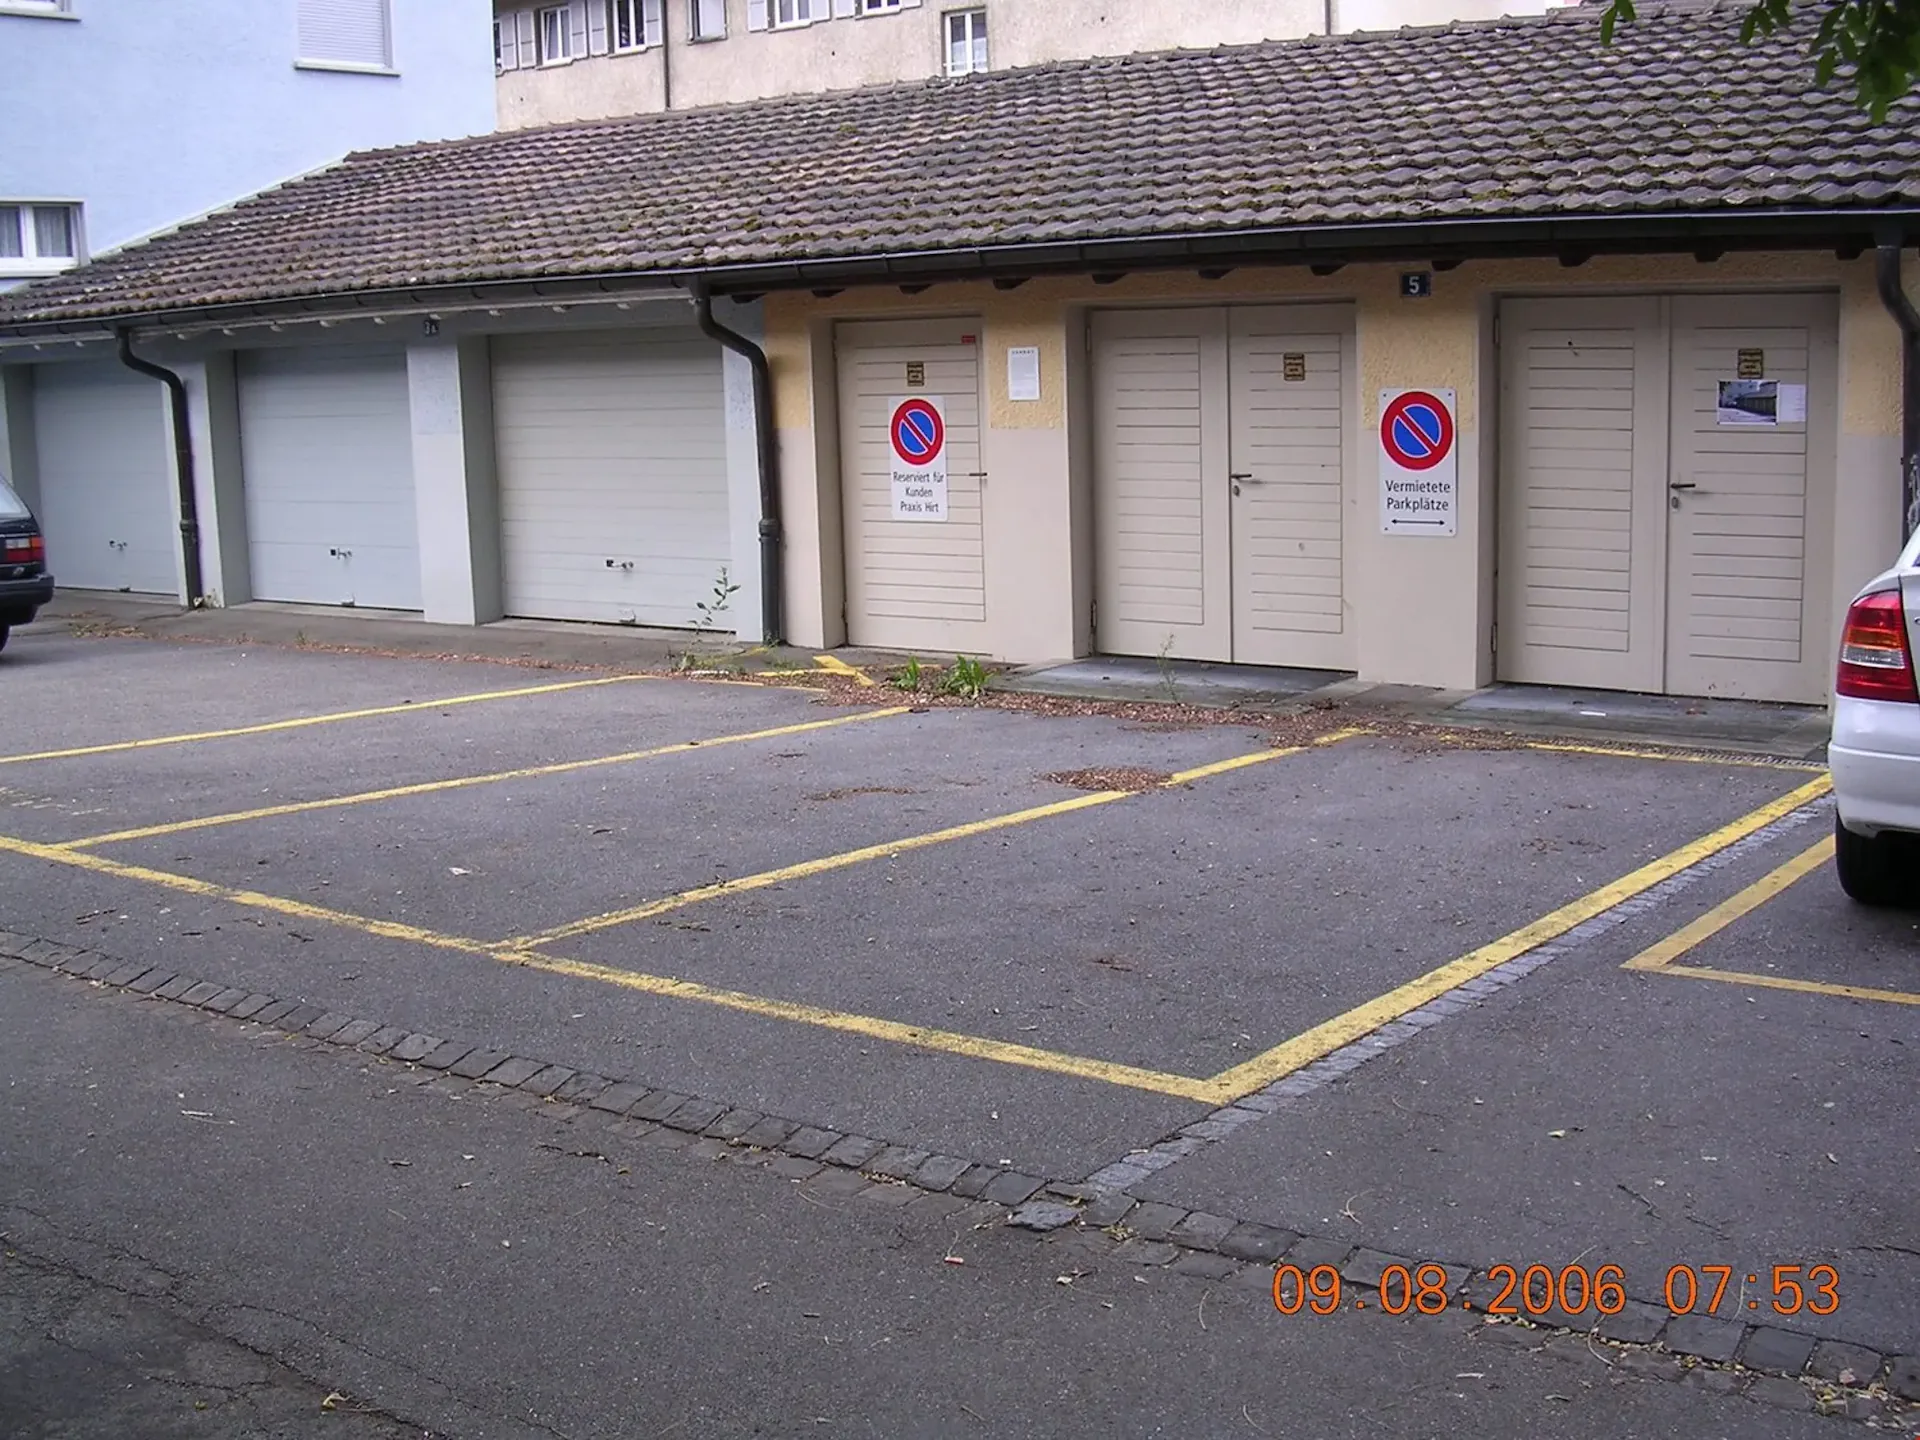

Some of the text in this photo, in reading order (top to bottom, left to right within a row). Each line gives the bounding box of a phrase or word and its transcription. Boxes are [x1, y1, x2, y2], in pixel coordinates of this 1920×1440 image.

[1409, 275, 1420, 294] 5
[892, 470, 945, 483] Reserviert für
[905, 486, 934, 498] Kunden
[1384, 479, 1451, 493] Vermietete
[900, 500, 939, 513] Praxis Hirt
[1386, 496, 1449, 513] Parkplätze
